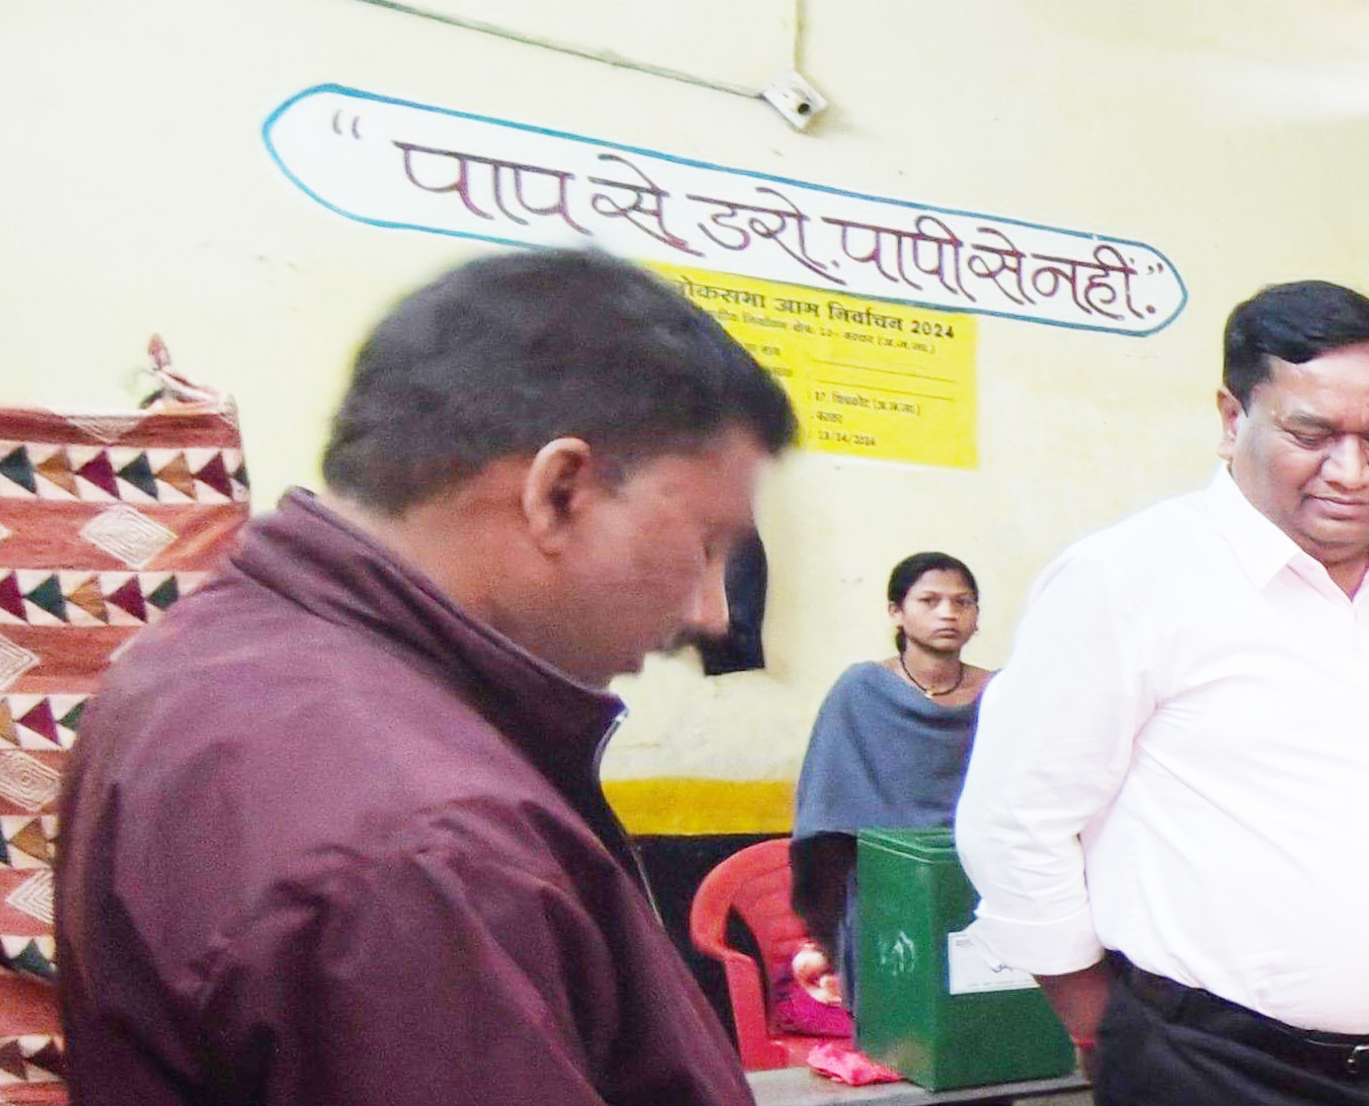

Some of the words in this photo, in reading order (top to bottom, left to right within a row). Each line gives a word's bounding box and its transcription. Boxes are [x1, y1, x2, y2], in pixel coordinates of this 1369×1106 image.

[588, 153, 706, 258] से
[820, 215, 976, 303] पापी
[966, 227, 1036, 305] से
[775, 296, 820, 319] आम
[910, 320, 955, 339] 2024
